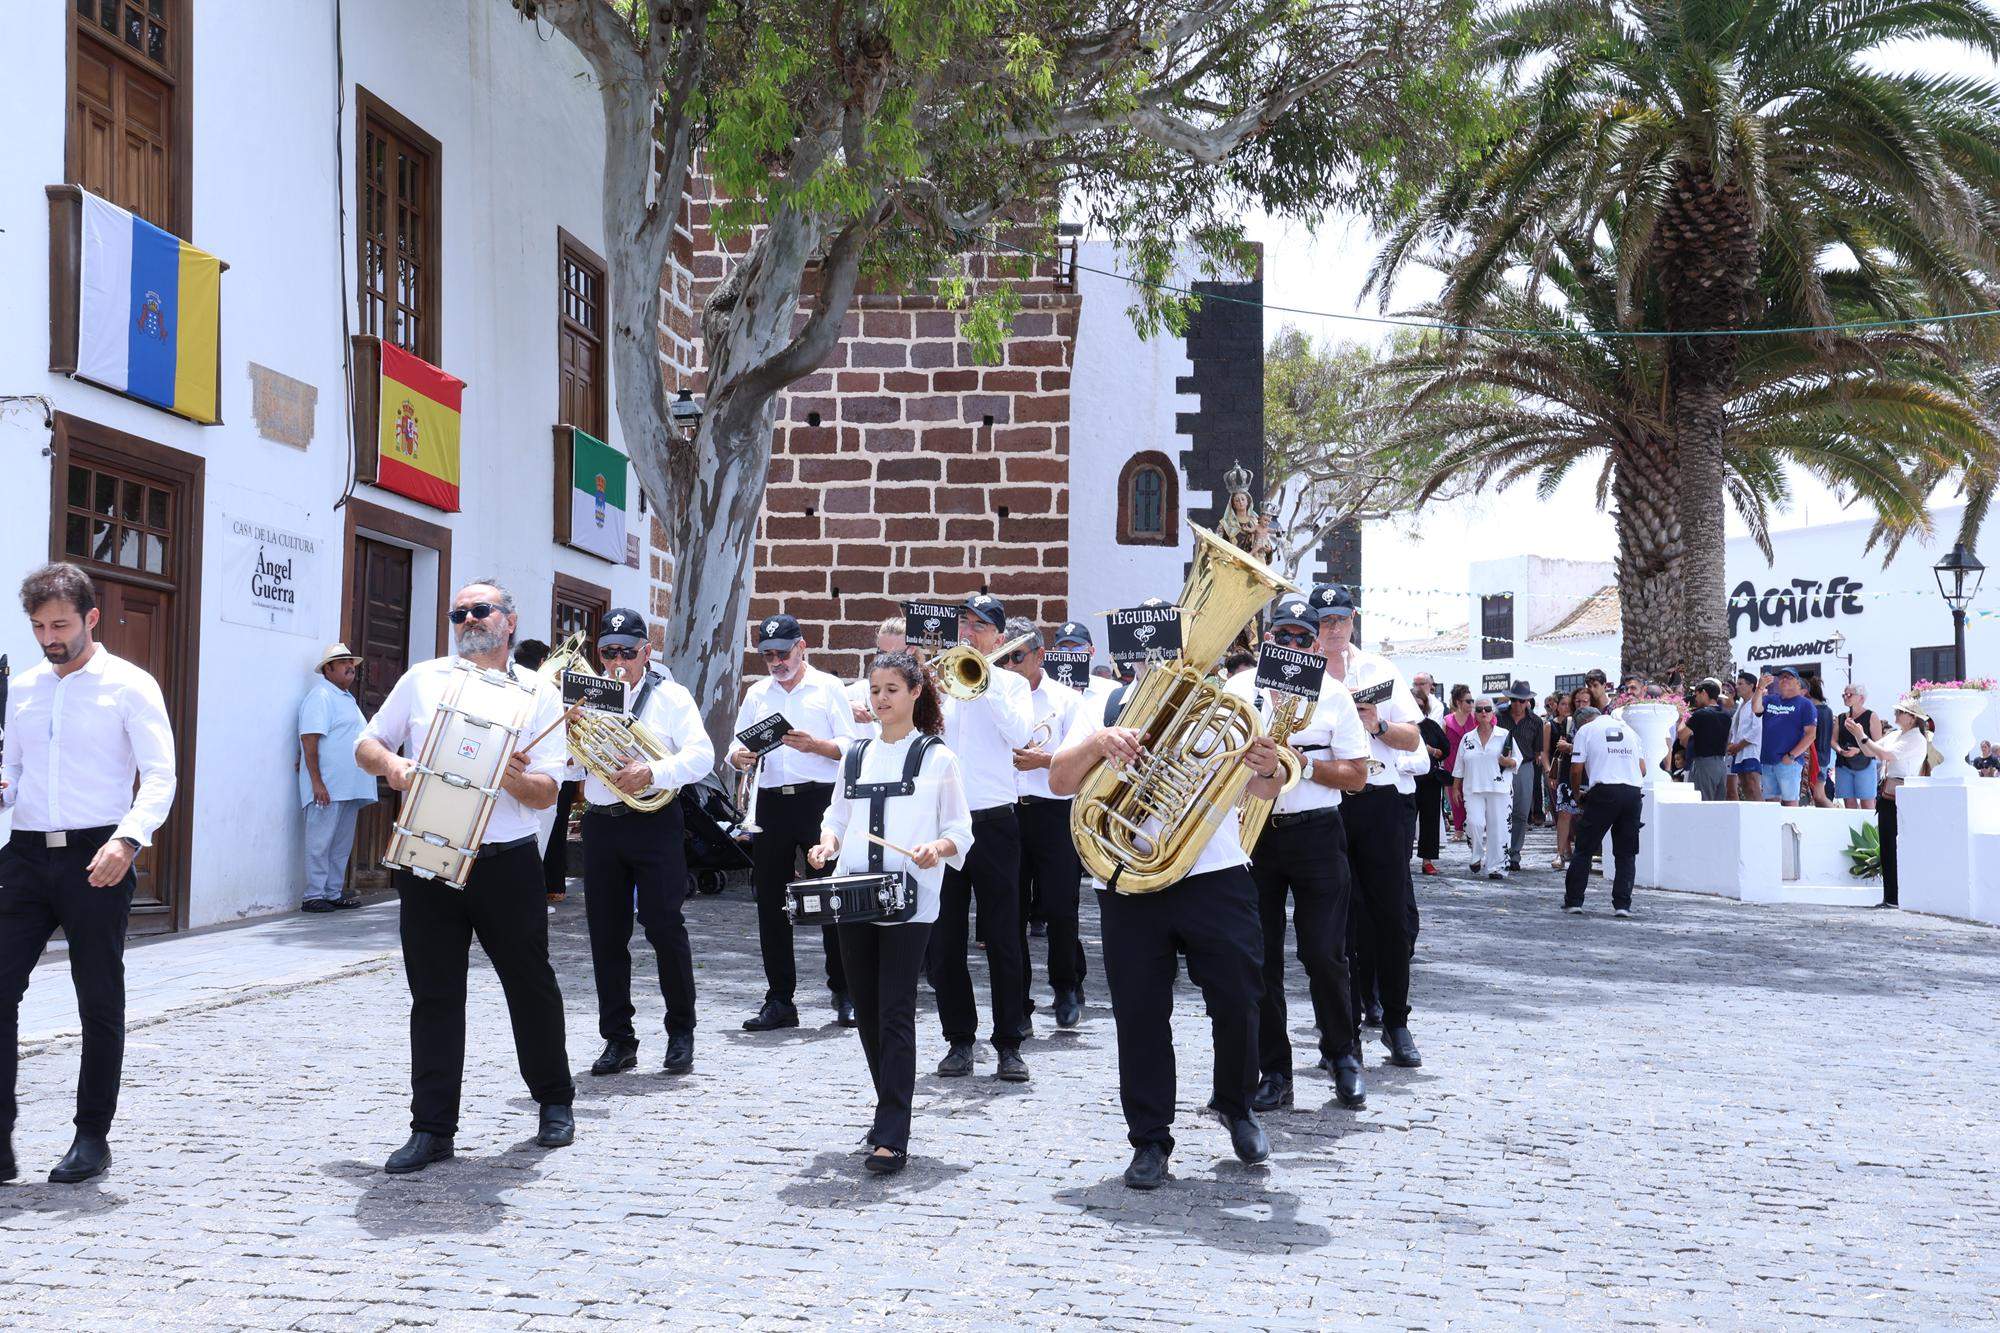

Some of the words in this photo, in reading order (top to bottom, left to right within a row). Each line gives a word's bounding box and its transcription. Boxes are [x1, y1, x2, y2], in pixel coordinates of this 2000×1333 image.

[233, 520, 253, 537] CASA
[254, 526, 266, 542] DE
[267, 529, 277, 545] LA
[279, 533, 315, 553] CULTURA
[255, 545, 292, 585] Ángel
[251, 574, 295, 604] Guerra
[910, 604, 956, 618] TEGUIBAND
[1112, 608, 1177, 625] TEGUIBAND
[1044, 652, 1088, 662] TEGUIBAND
[1265, 645, 1324, 669] TEGUIBAND
[1748, 639, 1836, 662] RESTAURANTE
[568, 674, 622, 691] TEGUIBAND
[1256, 675, 1271, 685] Banda
[1295, 685, 1301, 693] de
[1301, 686, 1319, 697] Teguise
[1354, 681, 1392, 698] GUIBAND
[740, 714, 782, 741] TEGUIBAND
